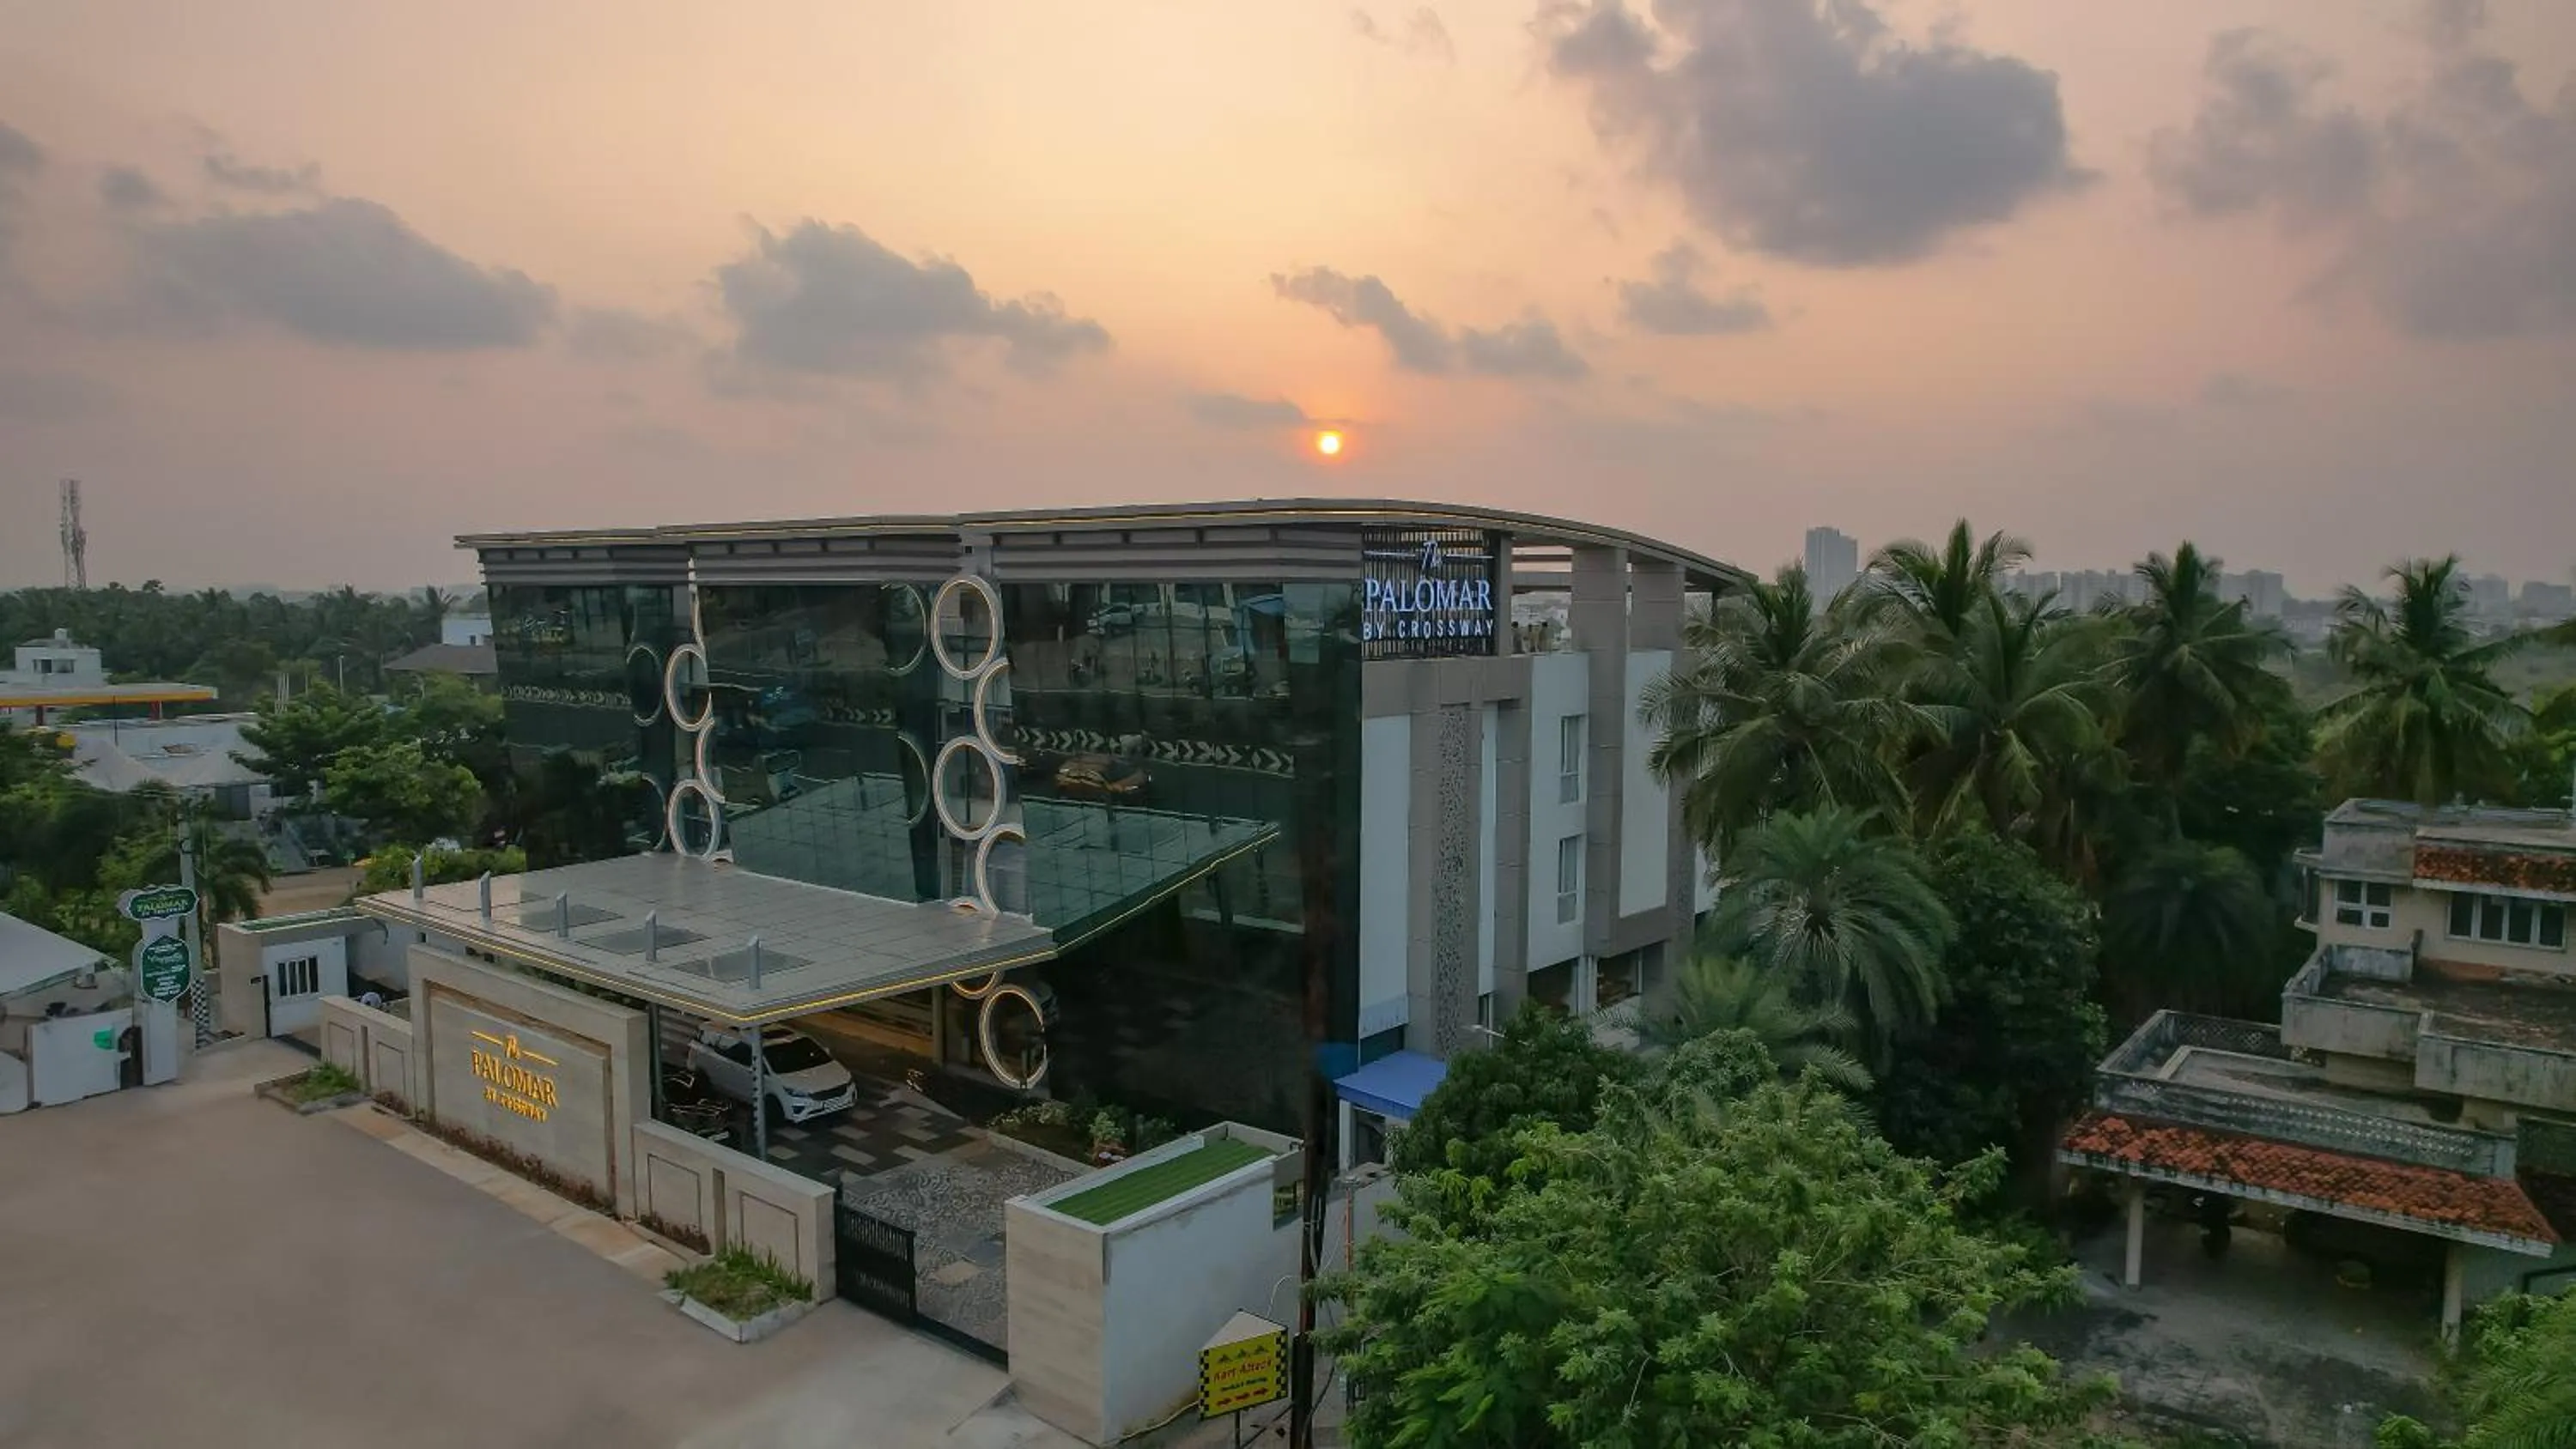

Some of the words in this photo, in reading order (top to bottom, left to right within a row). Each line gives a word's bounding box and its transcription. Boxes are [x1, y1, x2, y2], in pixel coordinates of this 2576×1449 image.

[1364, 577, 1493, 612] PALOMAR
[1362, 621, 1384, 640] BY
[1397, 619, 1494, 639] CROSSWAY
[471, 1048, 559, 1110] PALOMAR
